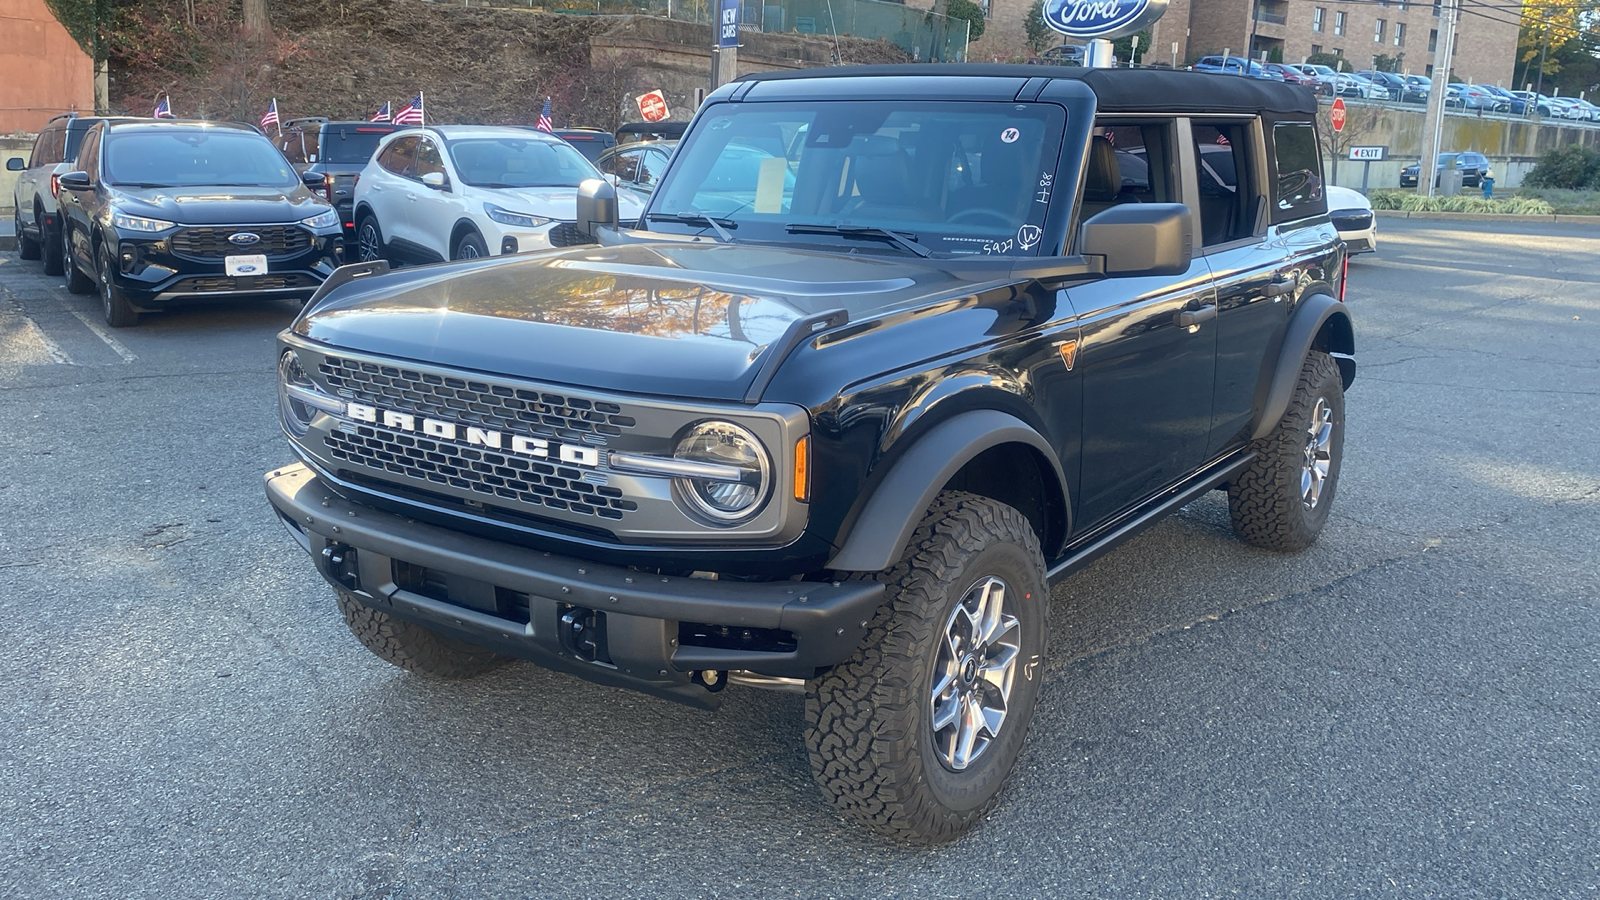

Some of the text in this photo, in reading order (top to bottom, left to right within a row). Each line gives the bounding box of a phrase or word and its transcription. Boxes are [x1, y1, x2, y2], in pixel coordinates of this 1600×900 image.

[722, 8, 736, 24] NEW
[1061, 0, 1121, 24] Ford
[722, 24, 736, 38] CARS
[1332, 108, 1345, 121] STOP
[1004, 130, 1017, 140] 14
[1360, 149, 1379, 157] EXIT
[348, 402, 599, 467] BRONCO
